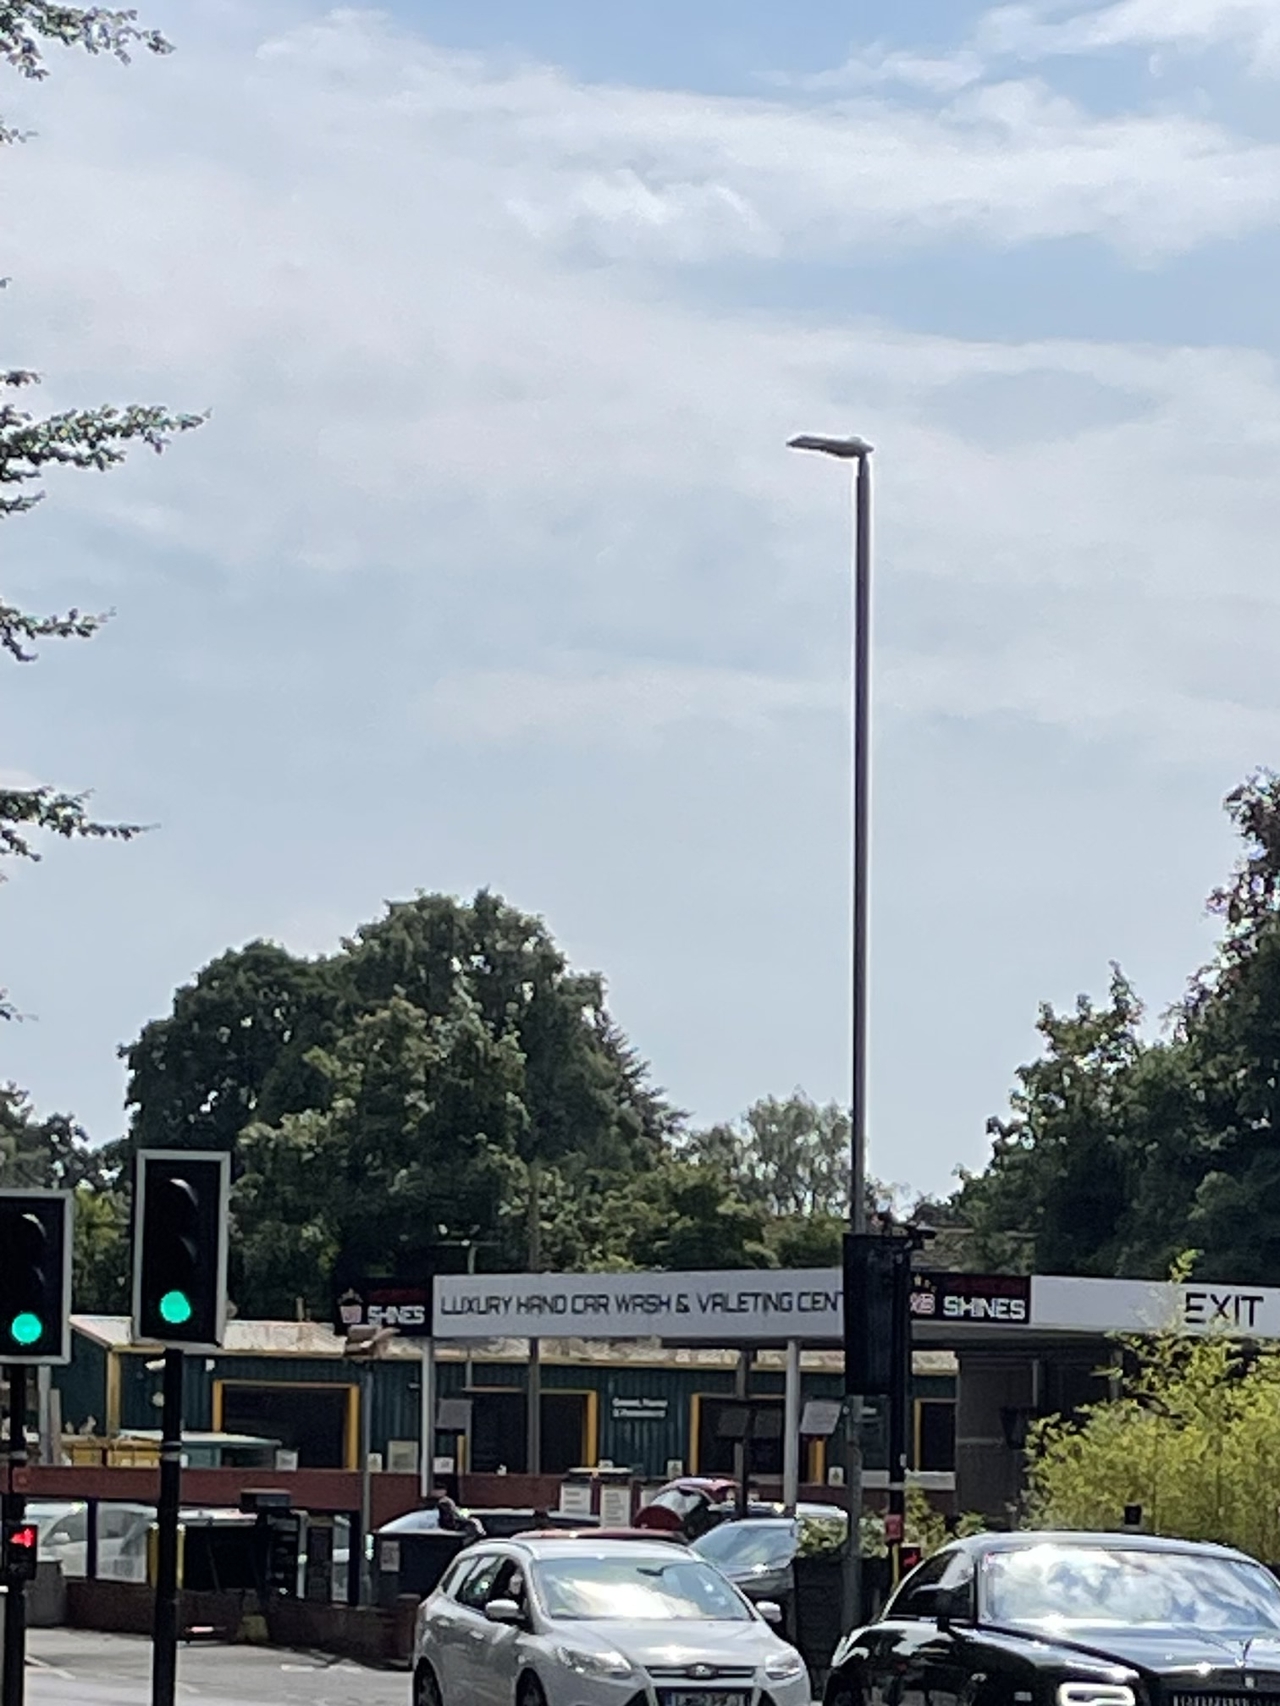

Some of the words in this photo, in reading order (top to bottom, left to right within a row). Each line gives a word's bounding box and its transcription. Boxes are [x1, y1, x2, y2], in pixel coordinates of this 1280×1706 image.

[440, 1295, 513, 1315] LUXURY
[516, 1294, 566, 1314] HAND
[571, 1294, 610, 1315] CAR
[615, 1293, 671, 1314] WASH
[675, 1294, 690, 1313] &
[697, 1291, 793, 1314] VALETING
[797, 1291, 844, 1312] CEN
[943, 1295, 1026, 1320] SHINES
[1184, 1291, 1264, 1328] EXIT
